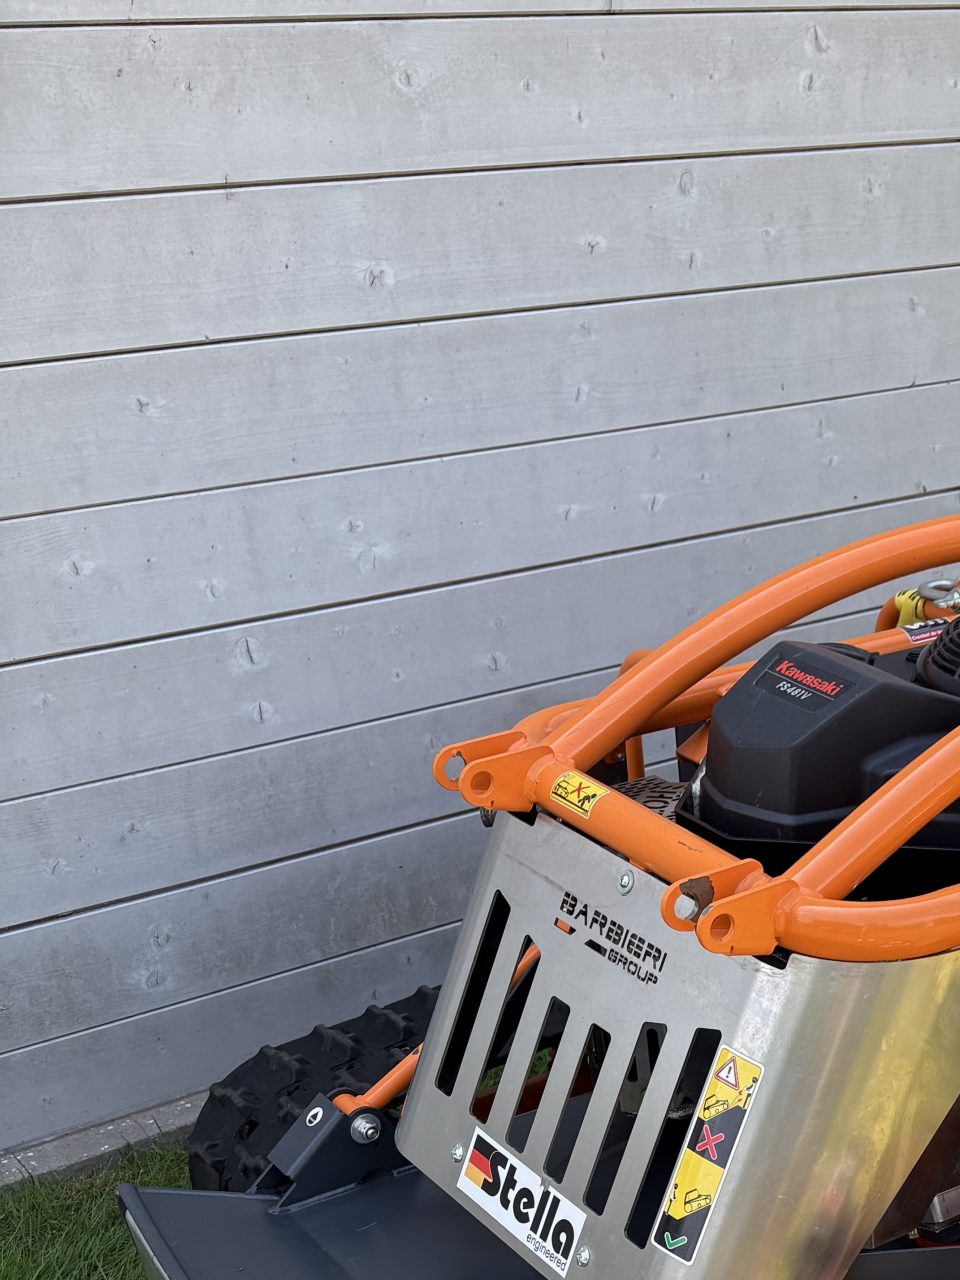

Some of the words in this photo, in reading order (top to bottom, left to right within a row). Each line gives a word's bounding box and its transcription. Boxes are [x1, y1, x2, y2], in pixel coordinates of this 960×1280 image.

[775, 660, 844, 696] Kawasaki
[776, 681, 812, 700] FS481V
[560, 891, 668, 973] BARBIERI
[607, 948, 659, 985] GROUP
[481, 1150, 575, 1261] Stella
[526, 1233, 567, 1271] engineered
